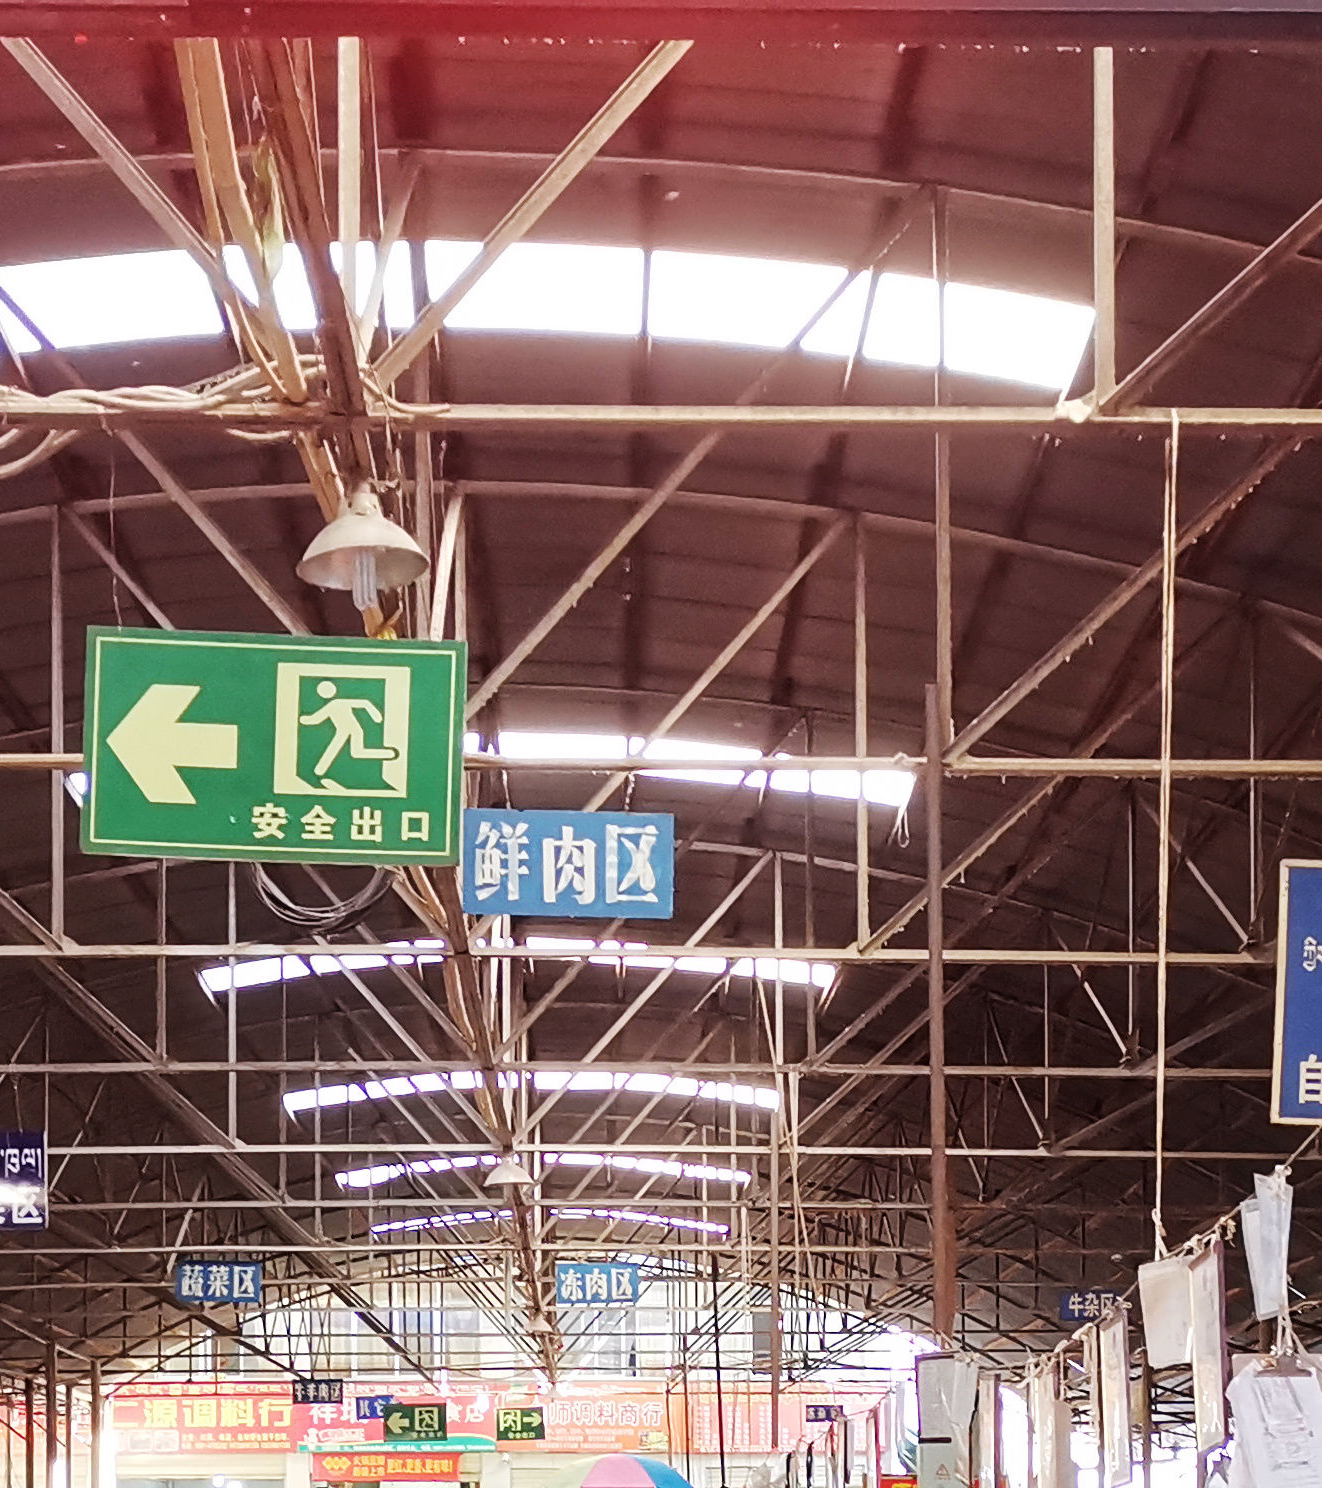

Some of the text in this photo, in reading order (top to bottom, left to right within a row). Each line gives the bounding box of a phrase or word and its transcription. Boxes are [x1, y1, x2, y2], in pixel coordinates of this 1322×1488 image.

[251, 803, 431, 842] 安全出口
[474, 820, 658, 905] 鲜肉区
[180, 1264, 256, 1298] 蔬菜区
[559, 1268, 633, 1301] 冻肉区
[1068, 1292, 1114, 1318] 牛杂区
